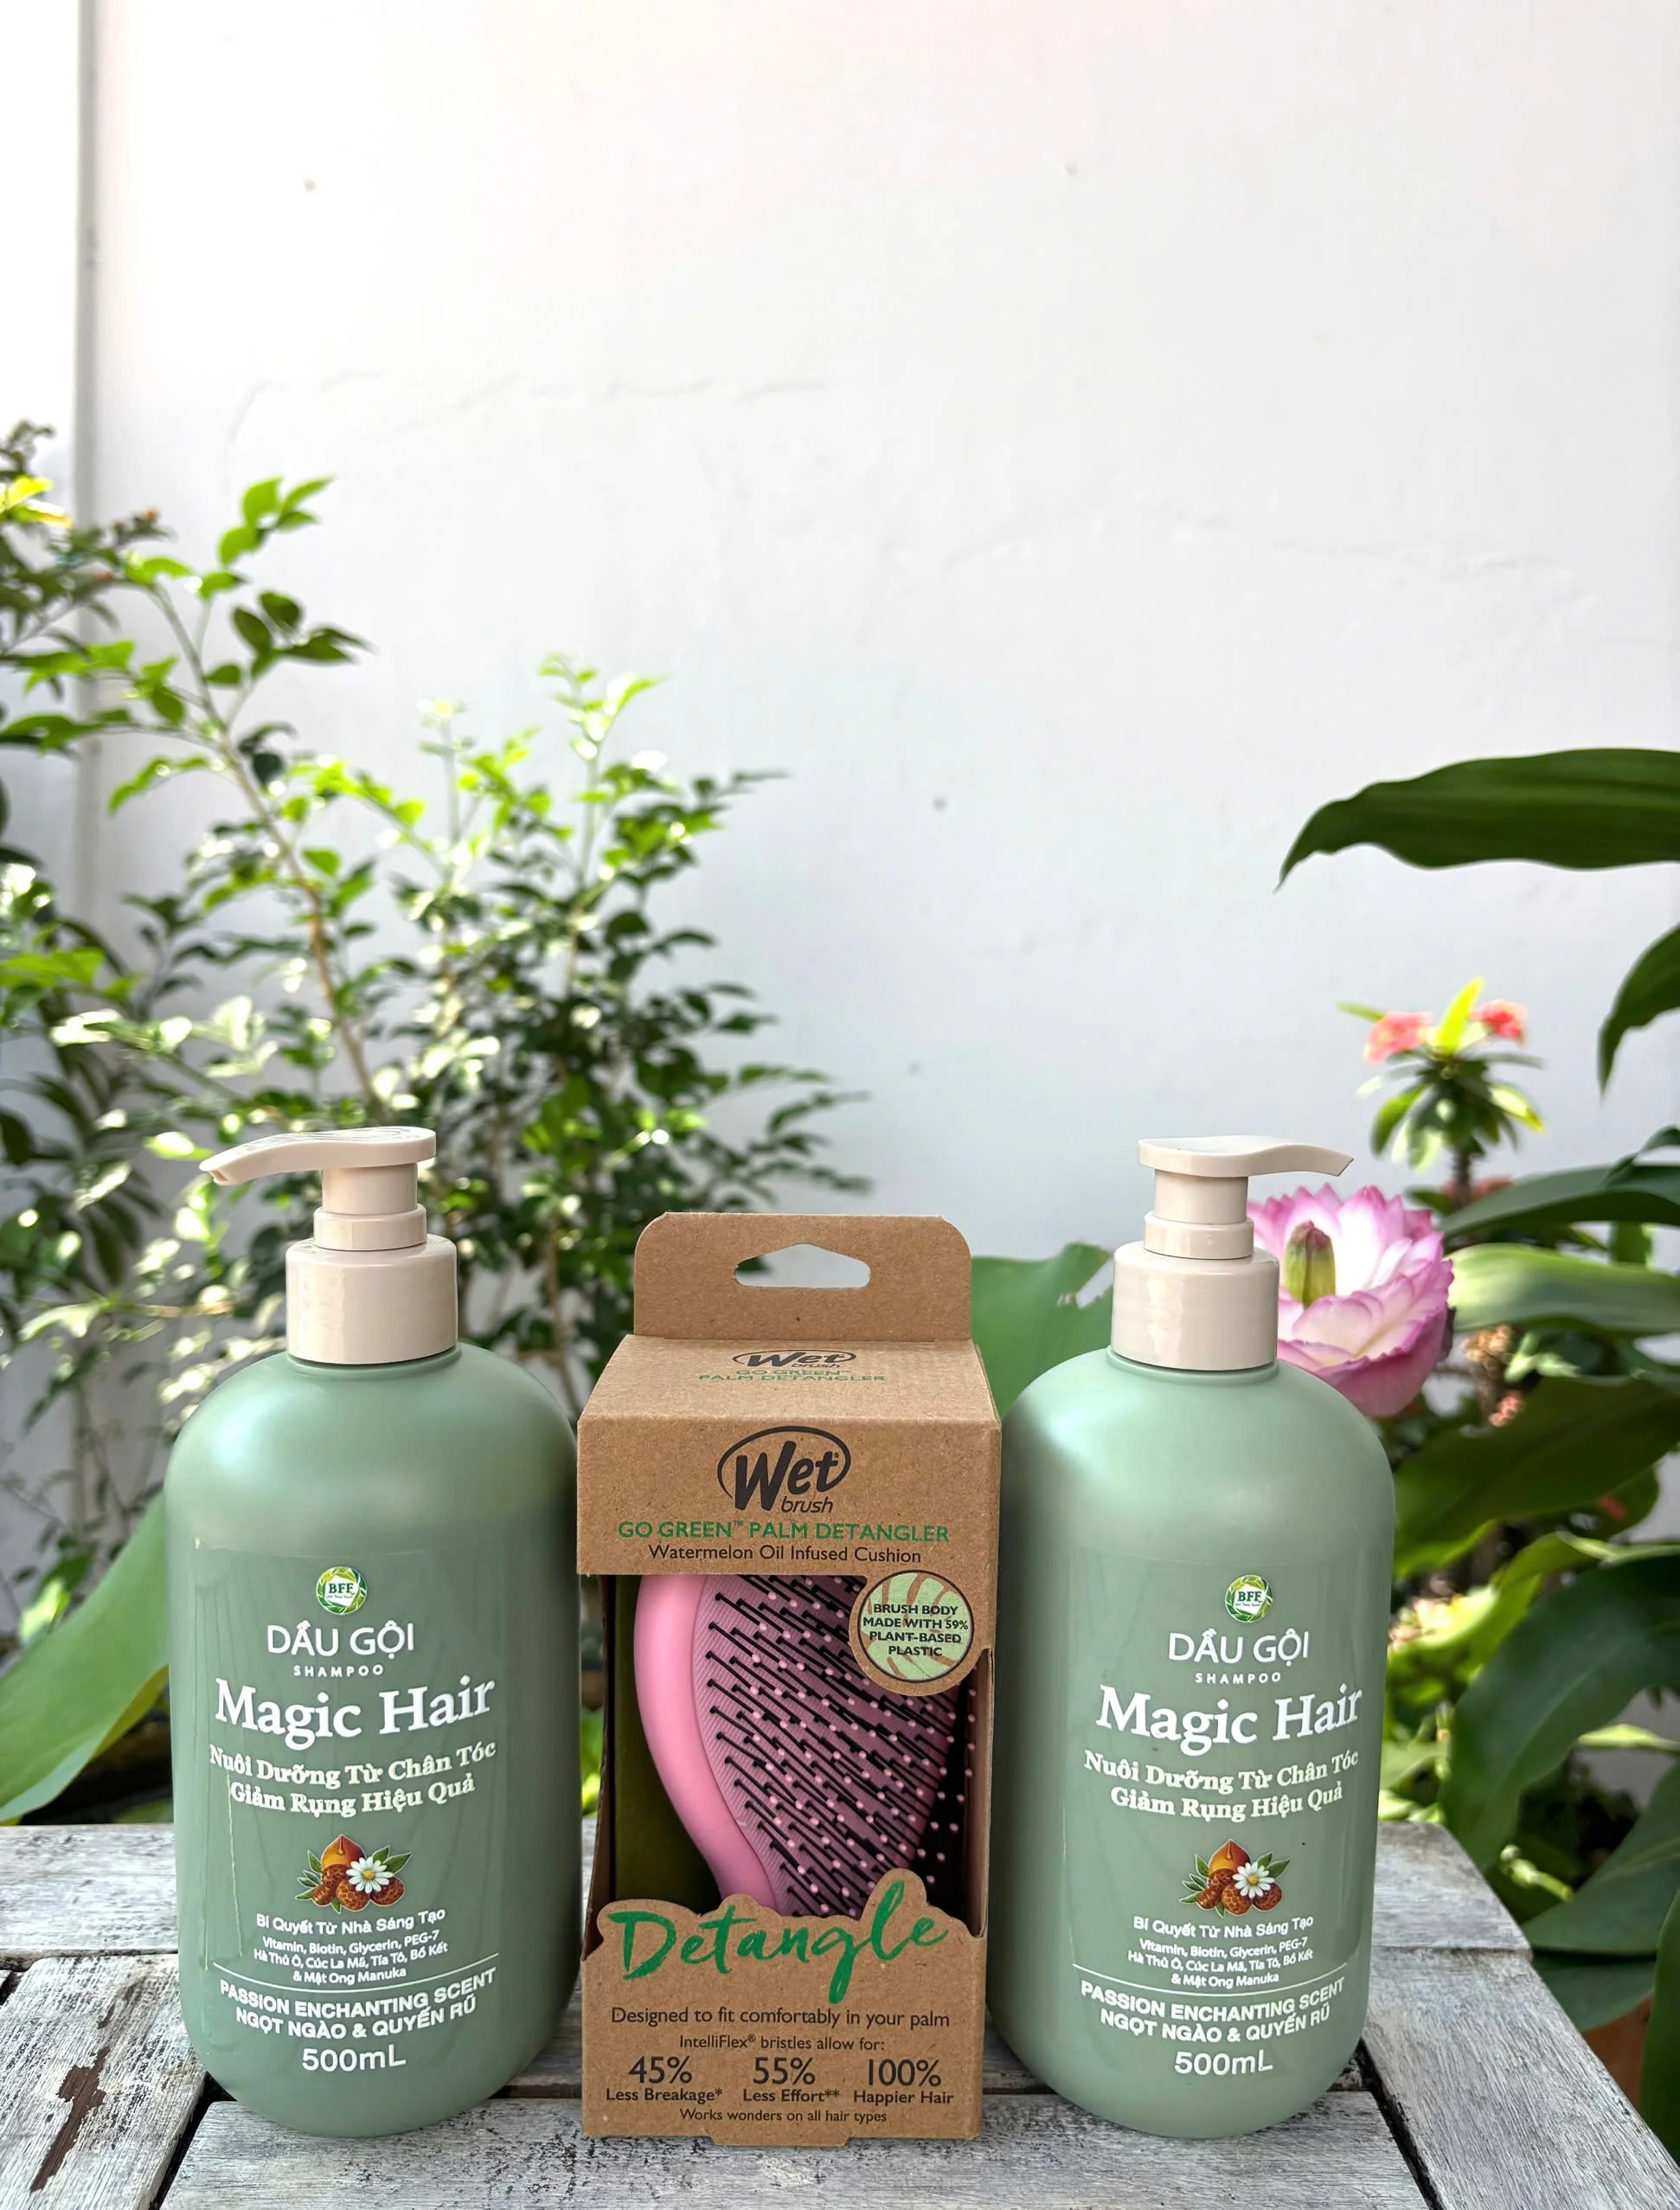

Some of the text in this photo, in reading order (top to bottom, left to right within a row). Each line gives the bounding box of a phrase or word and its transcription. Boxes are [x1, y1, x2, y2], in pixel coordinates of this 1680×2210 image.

[781, 1496, 834, 1513] brush
[618, 1520, 653, 1539] GO
[748, 1522, 808, 1539] PALM
[816, 1523, 949, 1542] DETANGLER
[648, 1544, 921, 1563] Watermelon Oil Infused Cushion
[873, 1603, 959, 1616] BRUSH BODY
[862, 1617, 969, 1630] MADE WITH 59%
[349, 1619, 414, 1660] GỘI
[869, 1631, 962, 1643] PLANT-BASED
[1254, 1628, 1309, 1667] GỘI
[888, 1645, 943, 1656] PLASTIC
[293, 1664, 384, 1677] SHAMPOO
[1195, 1672, 1281, 1685] SHAMPOO
[215, 1674, 495, 1751] Magic Hair
[1096, 1683, 1363, 1757] Magic Hair
[209, 1741, 497, 1789] Nuôi Dưỡng Từ Chân Tóc
[1084, 1749, 1359, 1795] Nuôi Dưỡng Từ Chân Tóc
[231, 1772, 476, 1818] Giảm Rụng Hiệu Quả
[1181, 1797, 1247, 1823] Rụng
[1251, 1794, 1303, 1818] Hiệu
[1307, 1780, 1343, 1812] Quả
[315, 1922, 337, 1935] Từ
[341, 1920, 373, 1934] Nhà
[375, 1917, 414, 1930] Sáng
[417, 1909, 446, 1924] Tạo
[1199, 1924, 1222, 1938] Từ
[1223, 1924, 1253, 1938] Nhà
[1255, 1922, 1289, 1937] Sáng
[1291, 1916, 1314, 1931] Tạo
[262, 1929, 439, 1956] Vitamin, Biotin, Glycerin, PEG-7
[606, 1879, 949, 2005] Detangle
[1139, 1936, 1308, 1960] Vitamin, Biotin, Glycerin, PEG-7
[330, 1957, 344, 1969] La
[1210, 1961, 1225, 1972] La
[292, 1970, 302, 1982] &
[329, 1972, 356, 1986] Ong
[357, 1967, 407, 1982] Manuka
[1170, 1973, 1182, 1985] &
[1208, 1976, 1234, 1989] Ong
[1235, 1972, 1279, 1987] Manuka
[220, 1967, 497, 2019] PASSION ENCHANTING SCENT
[1080, 1976, 1345, 2022] PASSION ENCHANTING SCENT
[235, 2007, 284, 2034] NGỌT
[287, 2020, 347, 2040] NGÀO
[352, 2023, 368, 2039] &
[450, 1993, 477, 2020] RŨ
[611, 2006, 950, 2031] Designed to fit comfortably in your palm
[1100, 2008, 1157, 2036] NGỌT
[1162, 2022, 1222, 2043] NGÀO
[1227, 2027, 1241, 2043] &
[1310, 2001, 1331, 2027] RŨ
[760, 2034, 811, 2050] bristles
[817, 2036, 855, 2050] allow
[859, 2037, 885, 2052] for:
[302, 2044, 407, 2072] 500mL
[628, 2055, 693, 2085] 45%
[753, 2056, 816, 2085] 55%
[1174, 2049, 1273, 2076] 500mL
[869, 2059, 942, 2087] 100%
[606, 2088, 638, 2101] Less
[743, 2089, 776, 2102] Less
[853, 2090, 954, 2107] Happier Hair
[679, 2108, 887, 2124] Works wonders on all hair types
